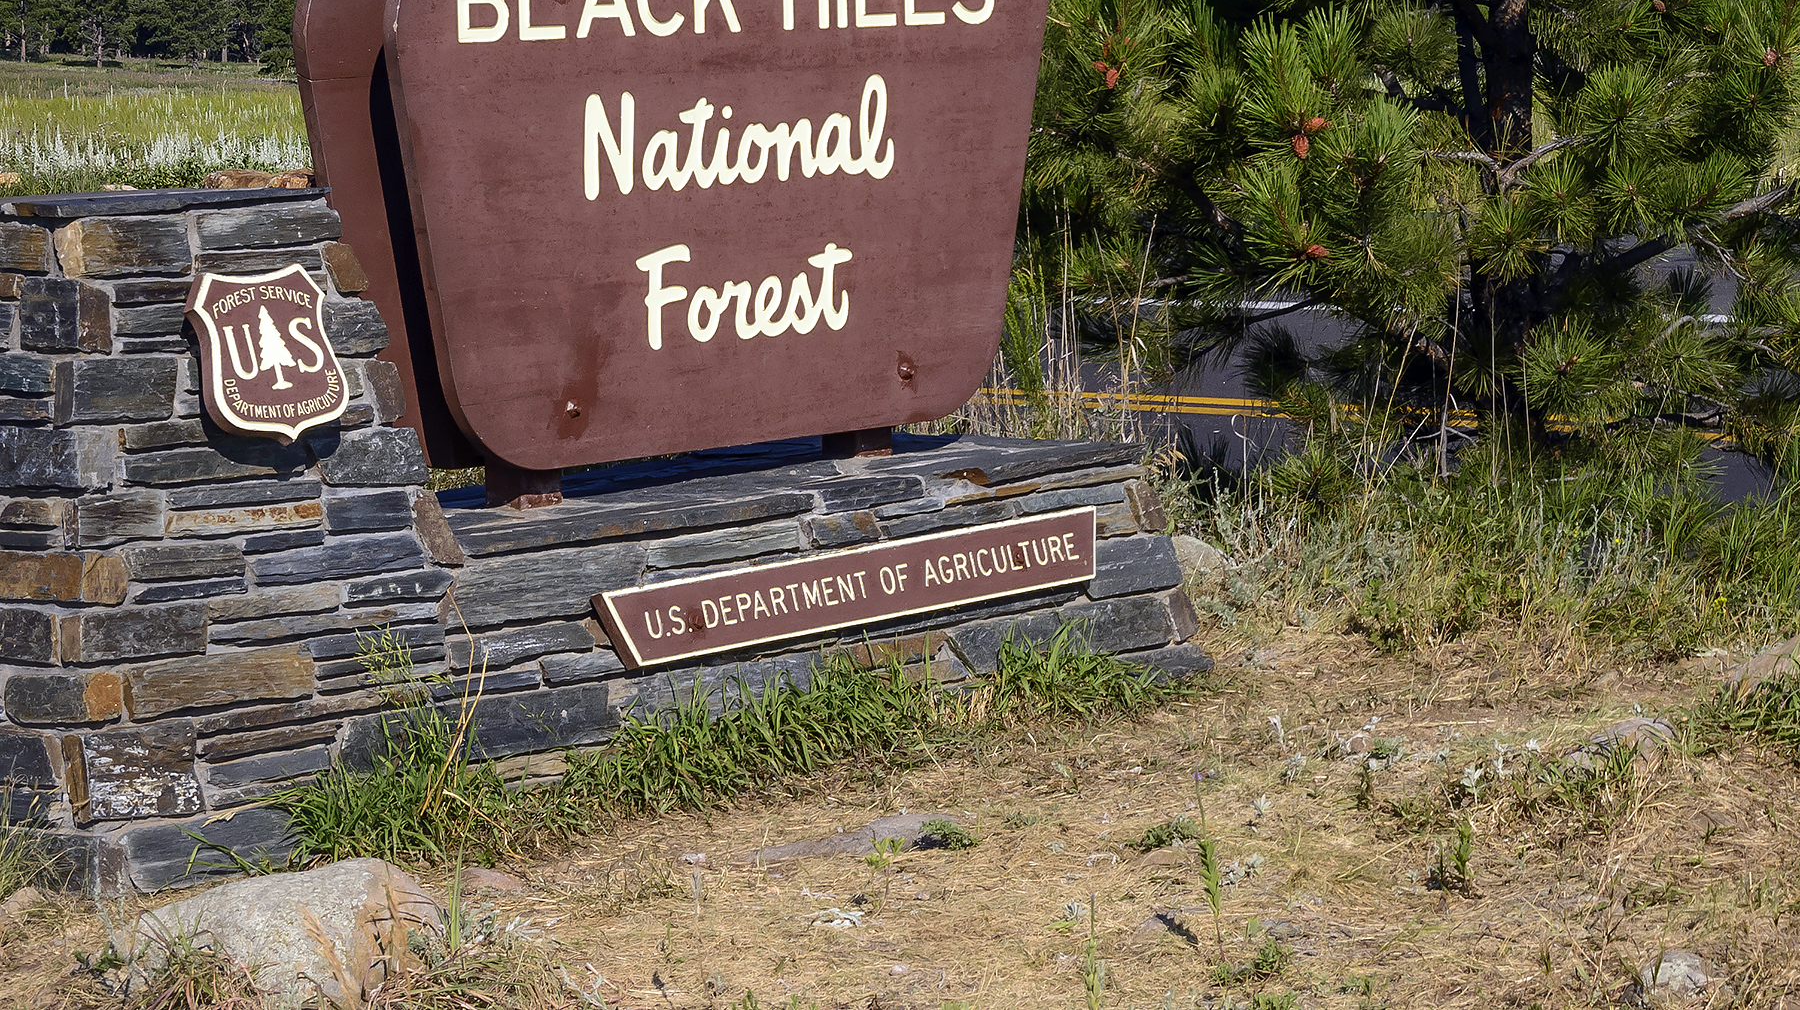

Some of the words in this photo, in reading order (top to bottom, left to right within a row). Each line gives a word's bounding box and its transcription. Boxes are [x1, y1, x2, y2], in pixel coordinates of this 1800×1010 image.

[583, 73, 895, 201] National
[212, 286, 256, 319] FOREST
[259, 285, 313, 309] SERVICE
[635, 242, 853, 350] Forest
[223, 378, 281, 419] DEPARTMENT
[283, 404, 296, 418] OF
[297, 368, 340, 416] AGRICULTURE
[644, 605, 694, 640] U.S.
[700, 570, 867, 630] DEPARTMENT
[879, 562, 908, 595] OF
[924, 532, 1080, 588] AGRICULTURE
